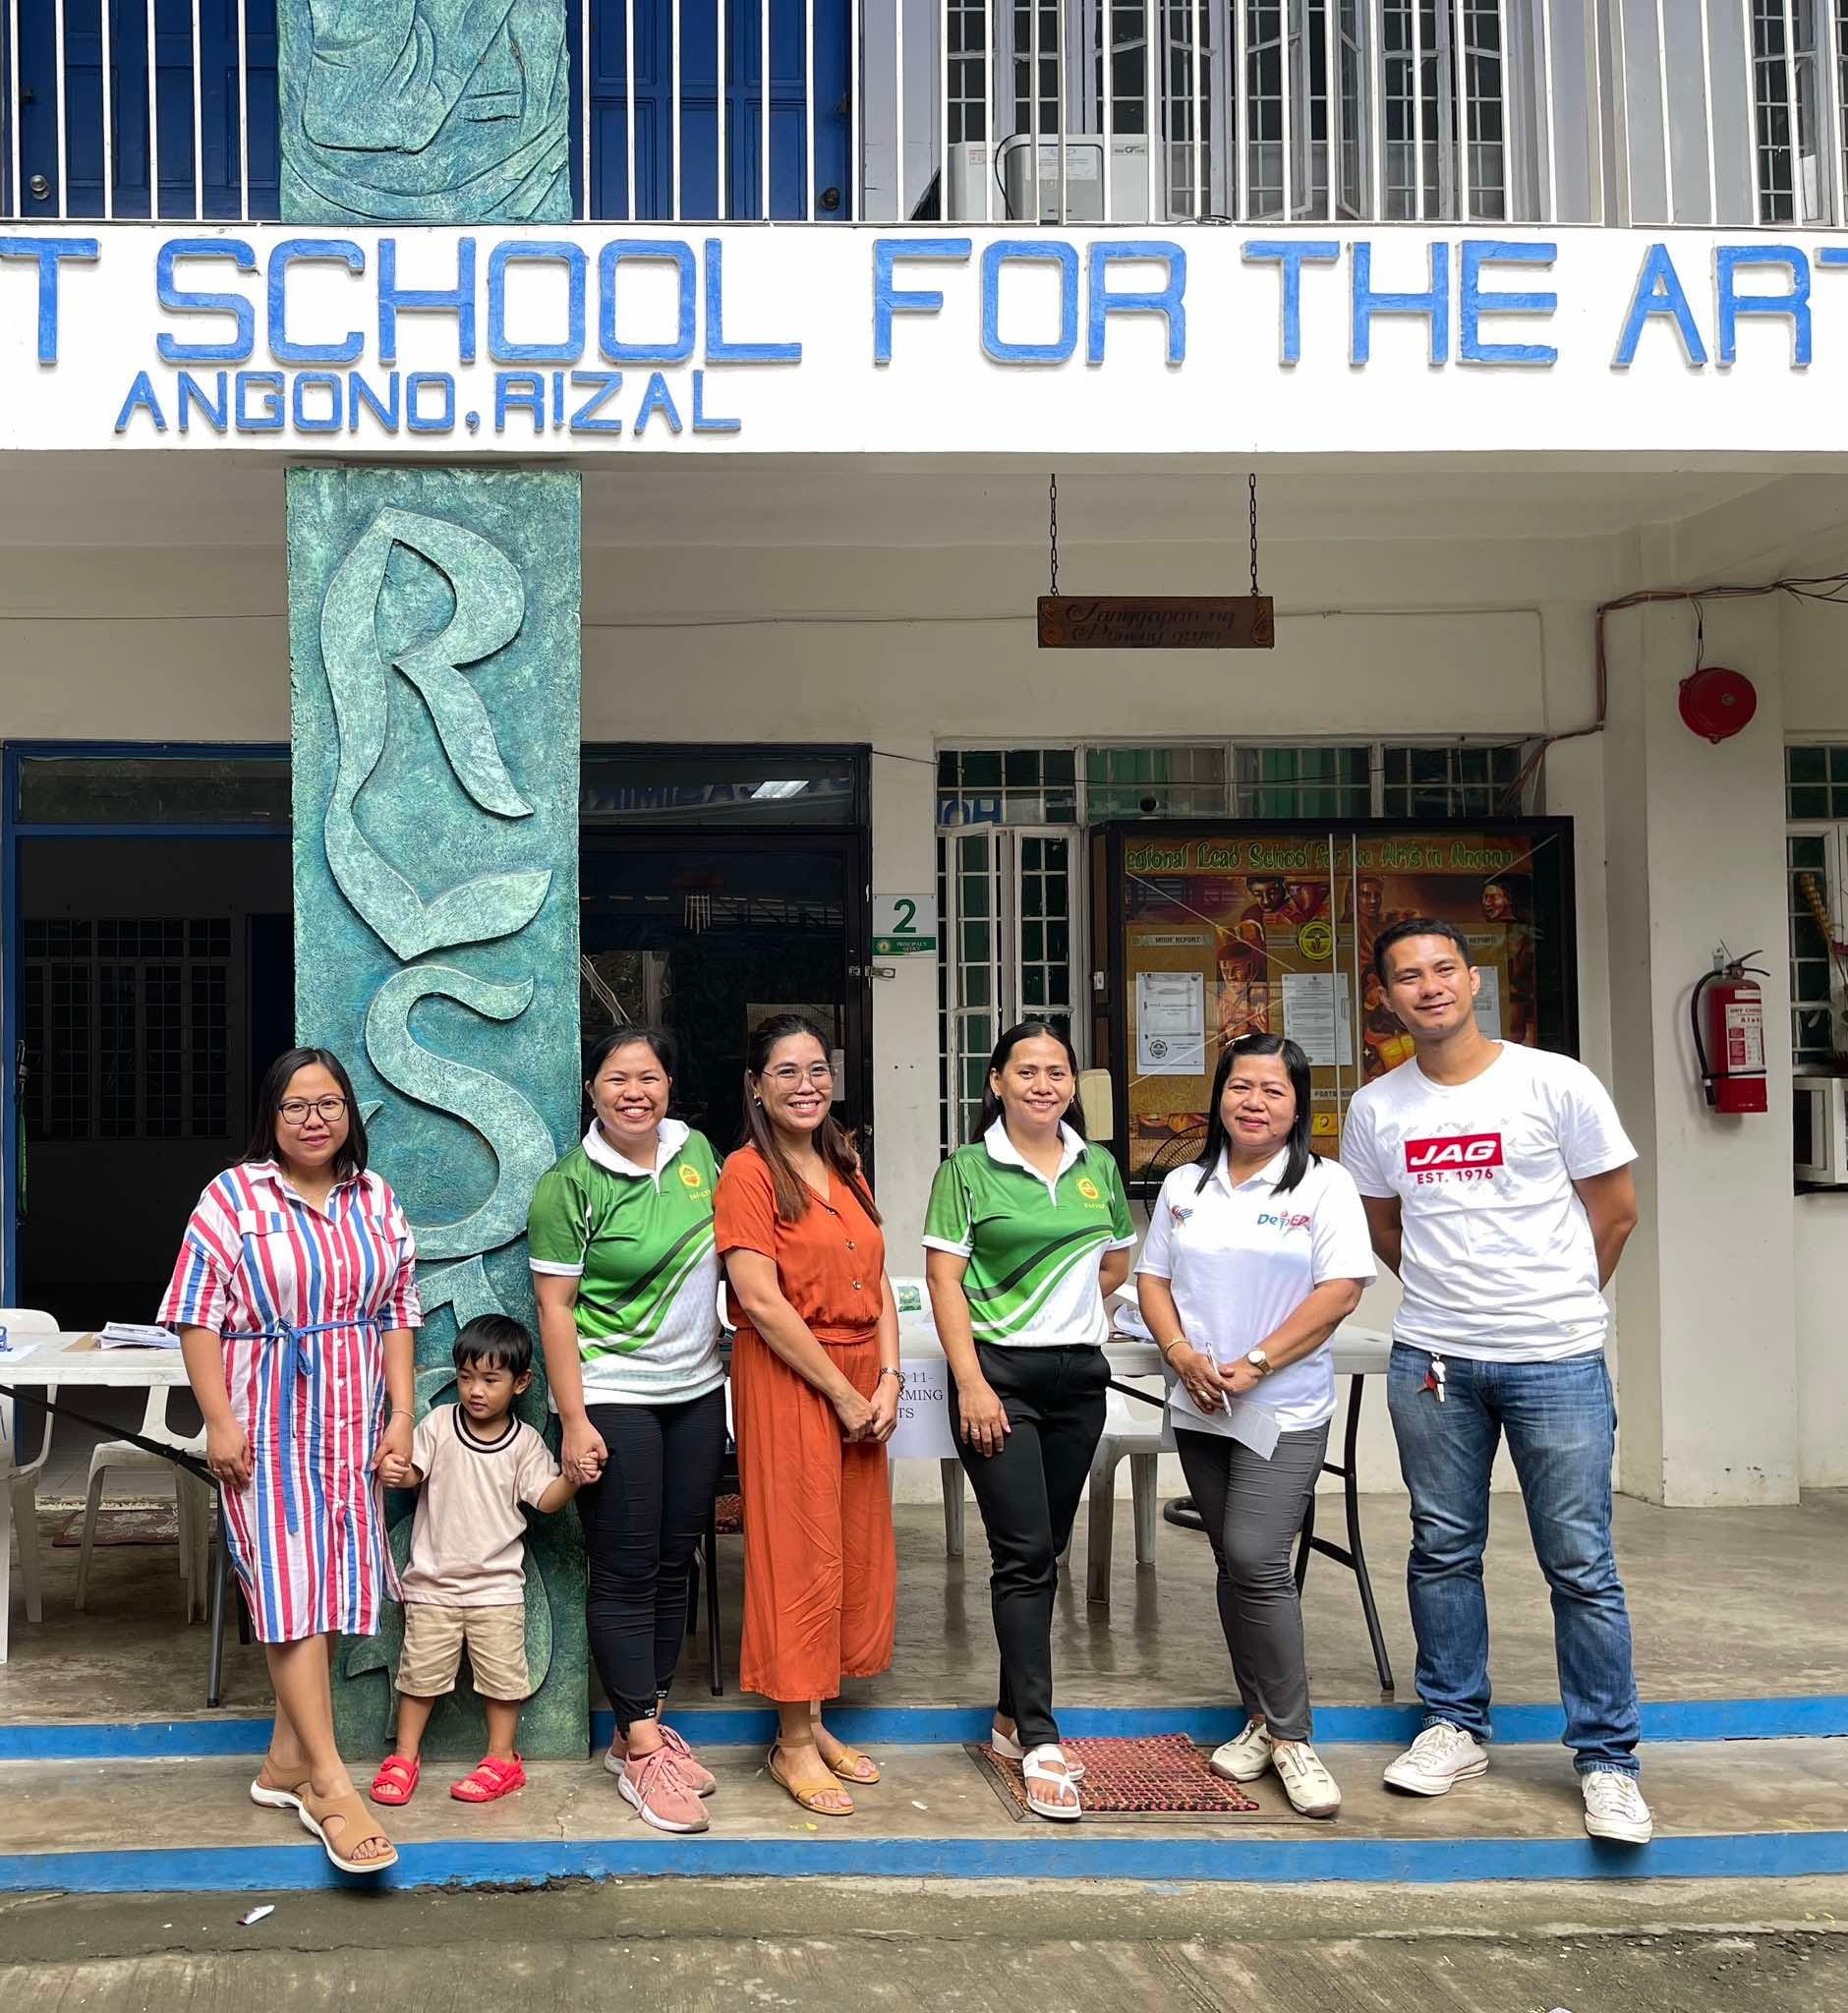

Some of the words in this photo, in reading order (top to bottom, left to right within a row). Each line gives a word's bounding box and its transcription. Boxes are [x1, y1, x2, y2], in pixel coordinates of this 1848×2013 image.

[156, 237, 803, 365] SCHOOL
[873, 238, 1186, 366] FOR
[1242, 240, 1558, 368] THE
[1196, 841, 1242, 870] Lead
[1249, 841, 1314, 870] School
[893, 898, 916, 934] 2
[1410, 1140, 1497, 1167] JAG
[1416, 1172, 1449, 1184] EST.
[1456, 1168, 1494, 1181] 1976
